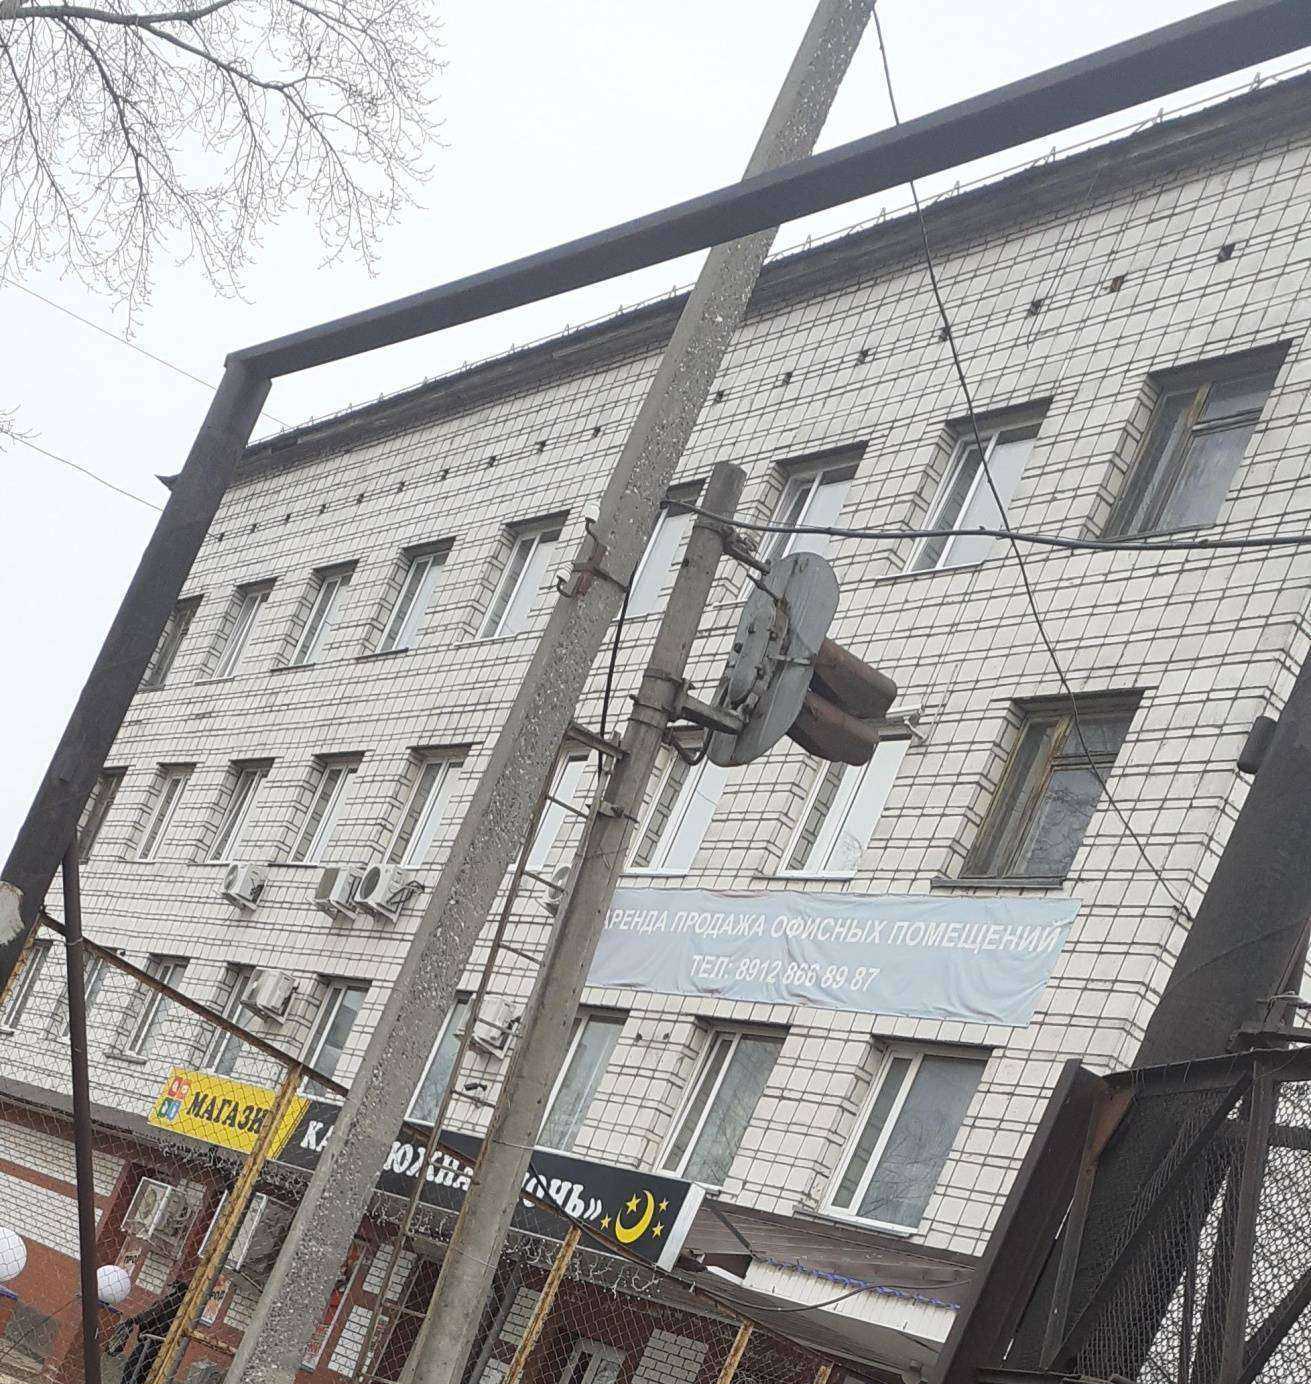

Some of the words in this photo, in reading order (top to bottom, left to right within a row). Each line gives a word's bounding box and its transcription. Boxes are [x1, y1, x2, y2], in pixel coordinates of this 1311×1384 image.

[670, 910, 765, 939] ПРОДАЖА
[771, 914, 889, 945] ОФИСНЫХ
[887, 919, 1062, 954] ПОМЕЩЕНИЙ
[689, 954, 733, 980] ТЕЛ:
[735, 957, 782, 984] 8912
[782, 962, 821, 987] 866
[820, 965, 849, 989] 89
[850, 966, 881, 992] 87
[186, 1091, 272, 1135] МАГАЗИ
[383, 1141, 475, 1191] ЮЖНА
[520, 1171, 603, 1221] ОЧЬ»
